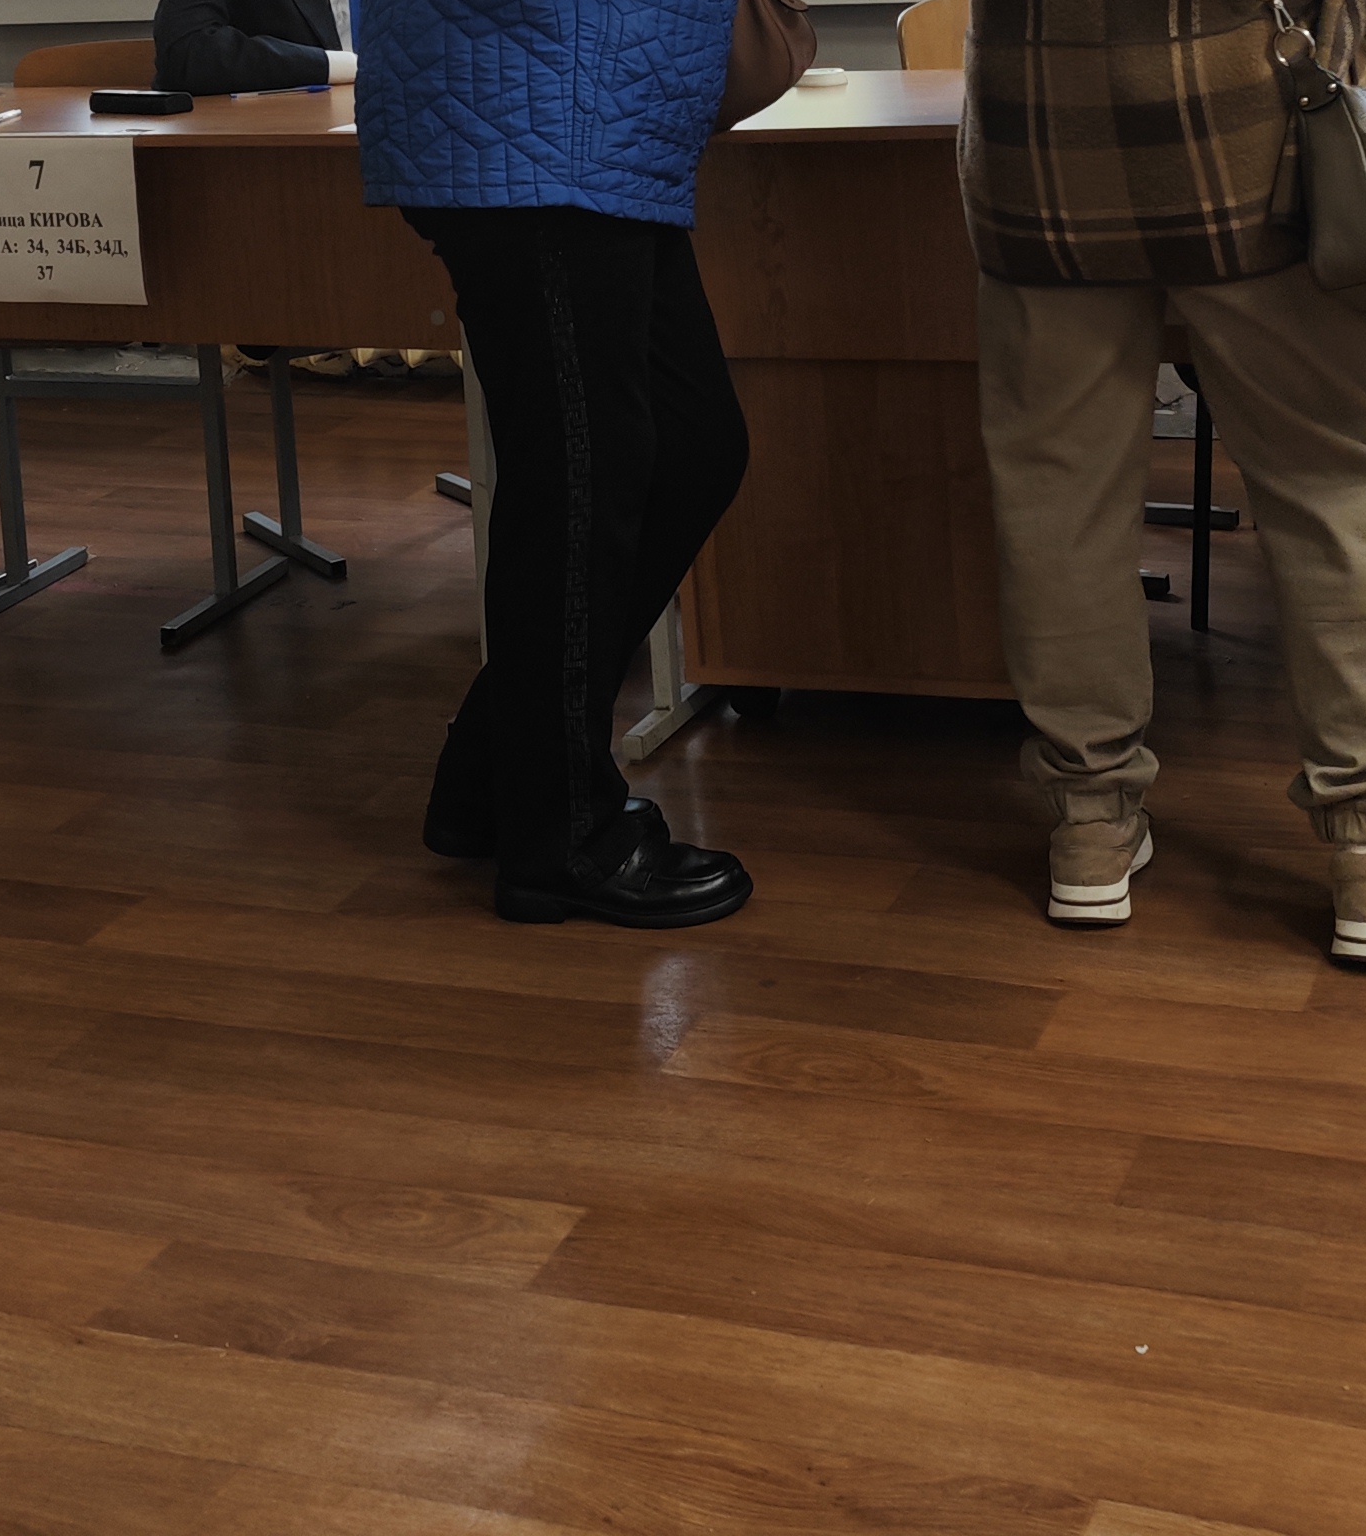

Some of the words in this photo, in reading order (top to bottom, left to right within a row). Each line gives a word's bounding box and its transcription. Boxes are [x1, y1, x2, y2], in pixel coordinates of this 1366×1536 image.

[28, 160, 45, 189] 7
[29, 212, 103, 228] КИРОВА
[27, 239, 50, 257] 34,
[56, 239, 91, 257] 34Б,
[94, 240, 129, 257] 34Д,
[37, 266, 54, 280] 37
